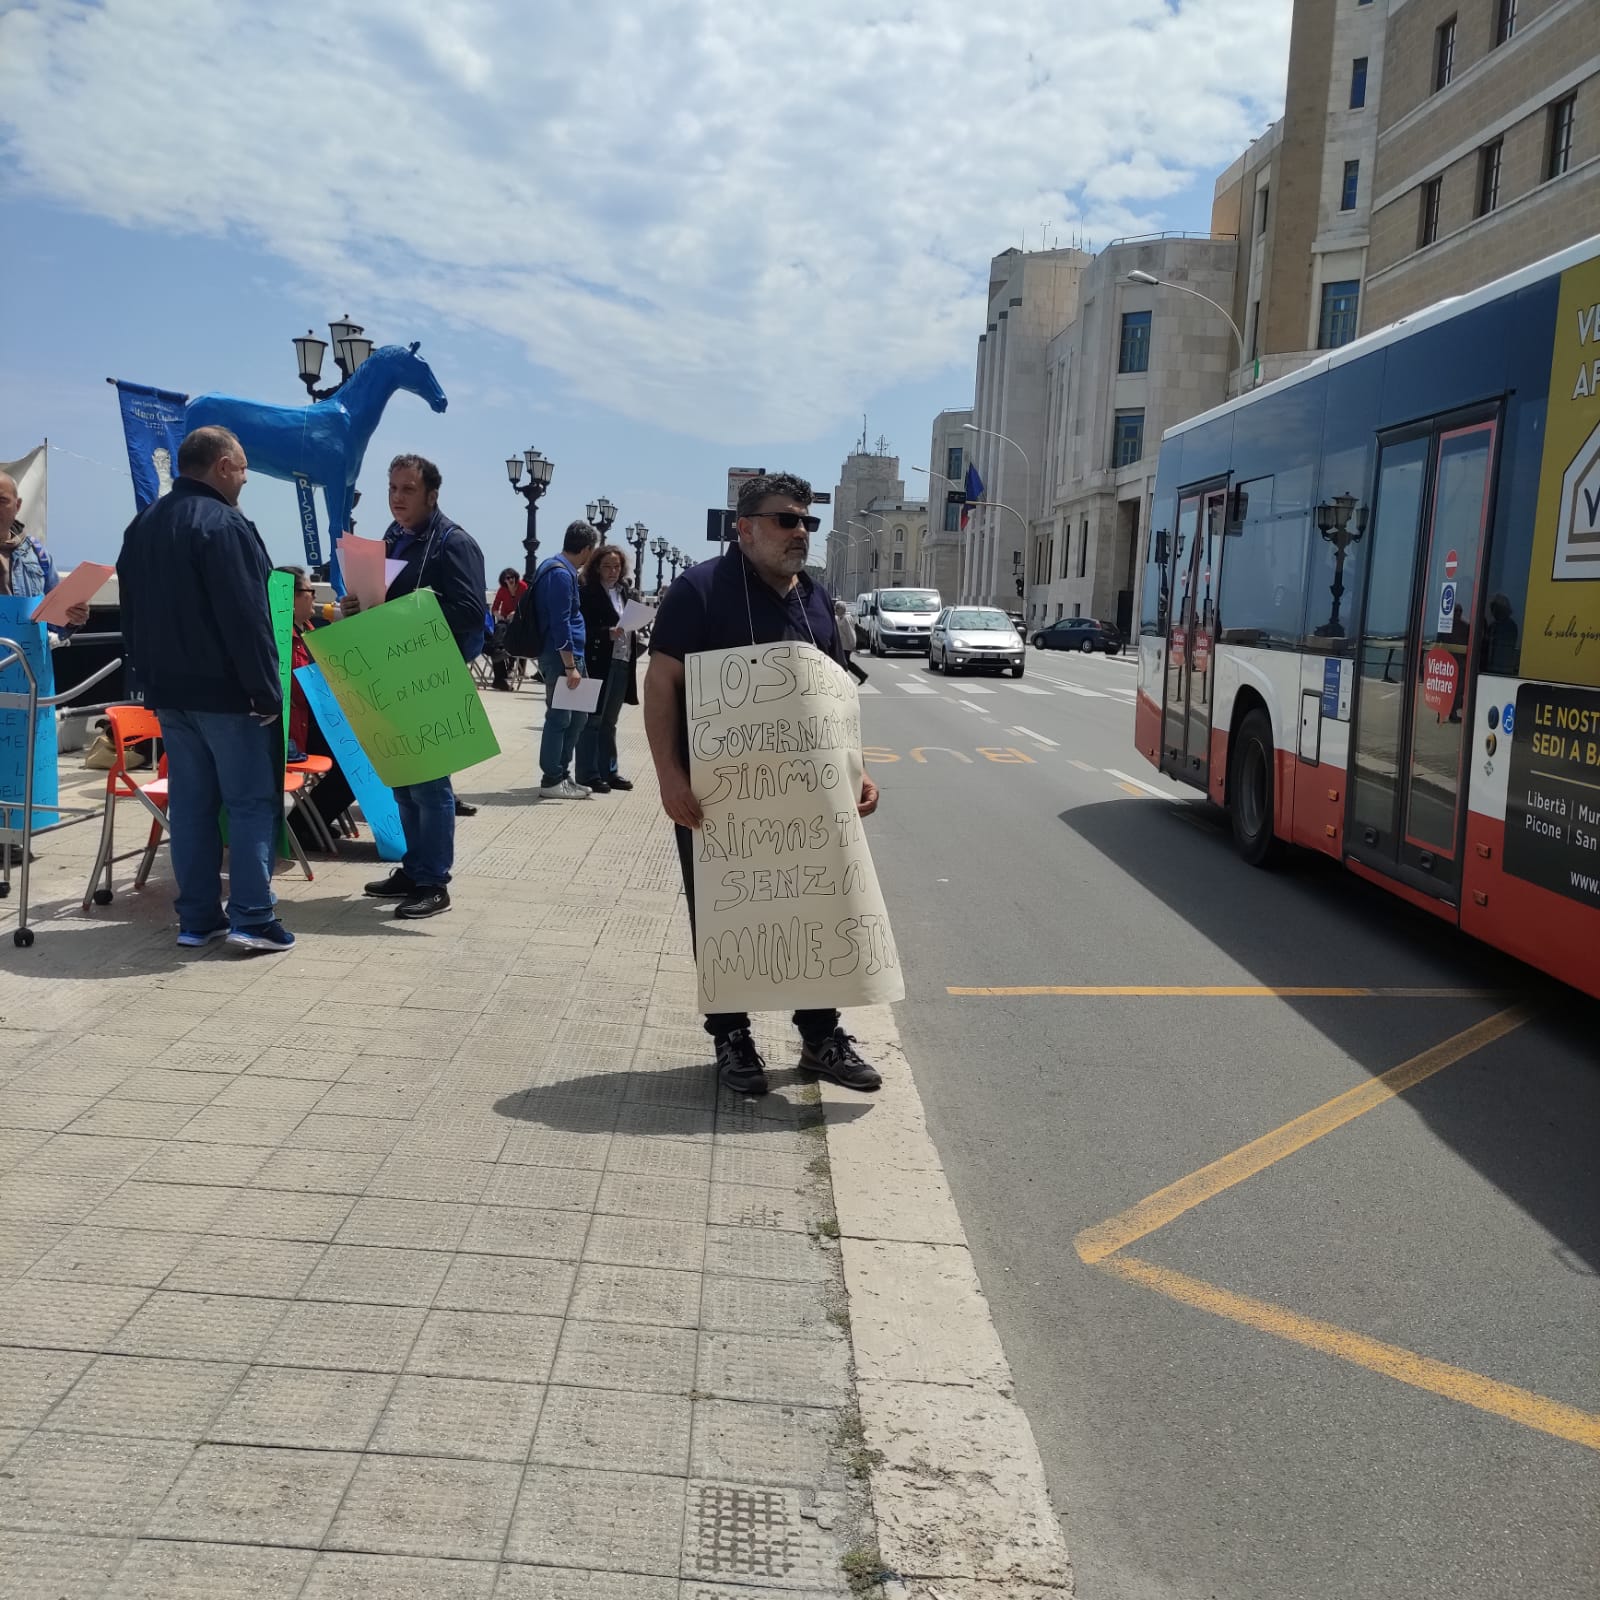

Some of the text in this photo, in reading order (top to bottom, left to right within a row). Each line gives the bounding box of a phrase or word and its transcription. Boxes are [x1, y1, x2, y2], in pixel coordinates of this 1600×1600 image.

[299, 478, 320, 561] RISPETTO
[387, 633, 431, 662] ANCHE
[423, 617, 450, 643] TU
[411, 667, 451, 697] NUOVI
[1427, 657, 1455, 677] Vietato
[1426, 677, 1453, 694] entrare
[1535, 703, 1600, 734] LE NOST
[862, 746, 1038, 764] BUS
[1532, 732, 1565, 759] SEDI
[1568, 739, 1581, 762] A
[1527, 789, 1567, 816] Libertà
[1525, 814, 1597, 851] Picone San
[713, 859, 866, 912] SENZA
[1569, 871, 1600, 895] www.
